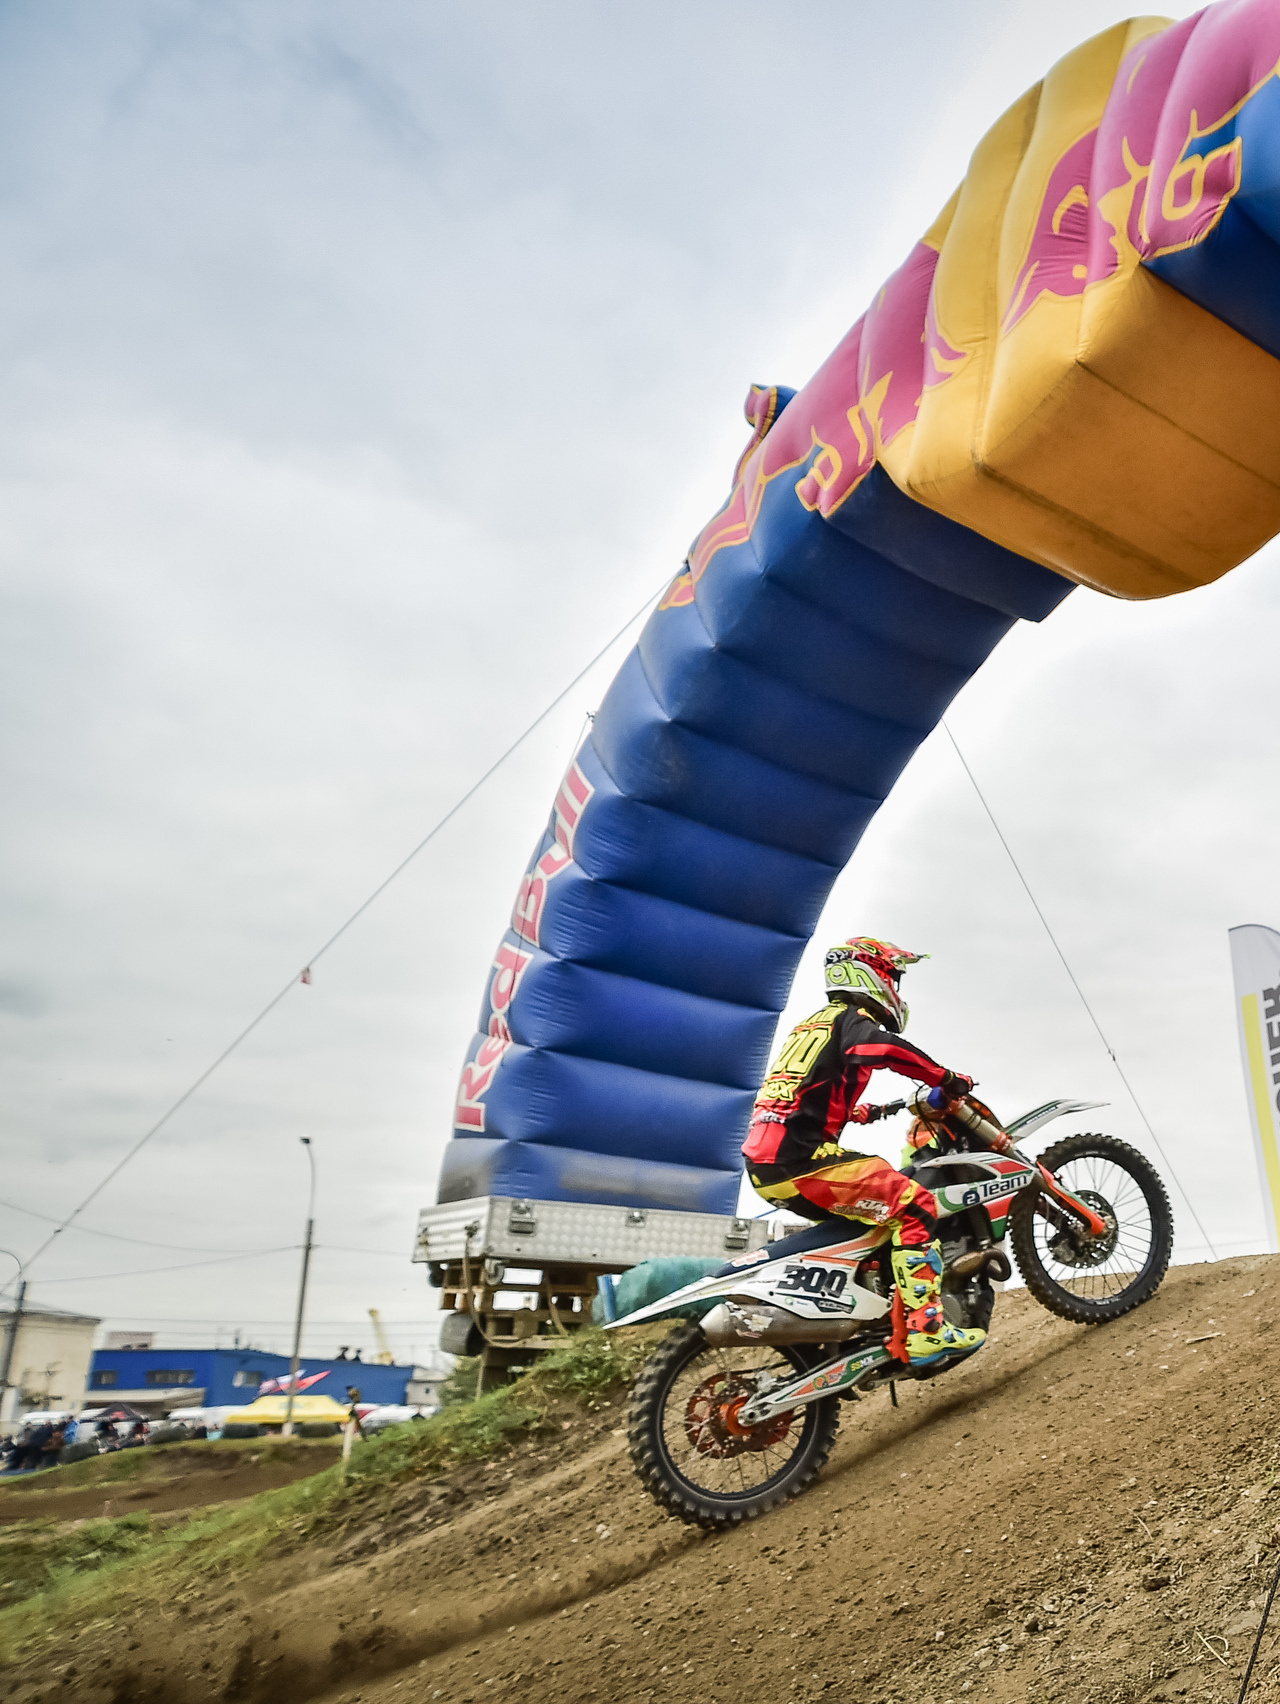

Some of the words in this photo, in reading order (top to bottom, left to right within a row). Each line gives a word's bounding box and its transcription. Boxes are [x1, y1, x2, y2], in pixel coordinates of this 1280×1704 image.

[454, 942, 534, 1132] Red
[511, 762, 594, 947] Bull
[979, 1175, 1028, 1198] Team
[855, 1199, 890, 1214] KTM
[777, 1264, 848, 1299] 300
